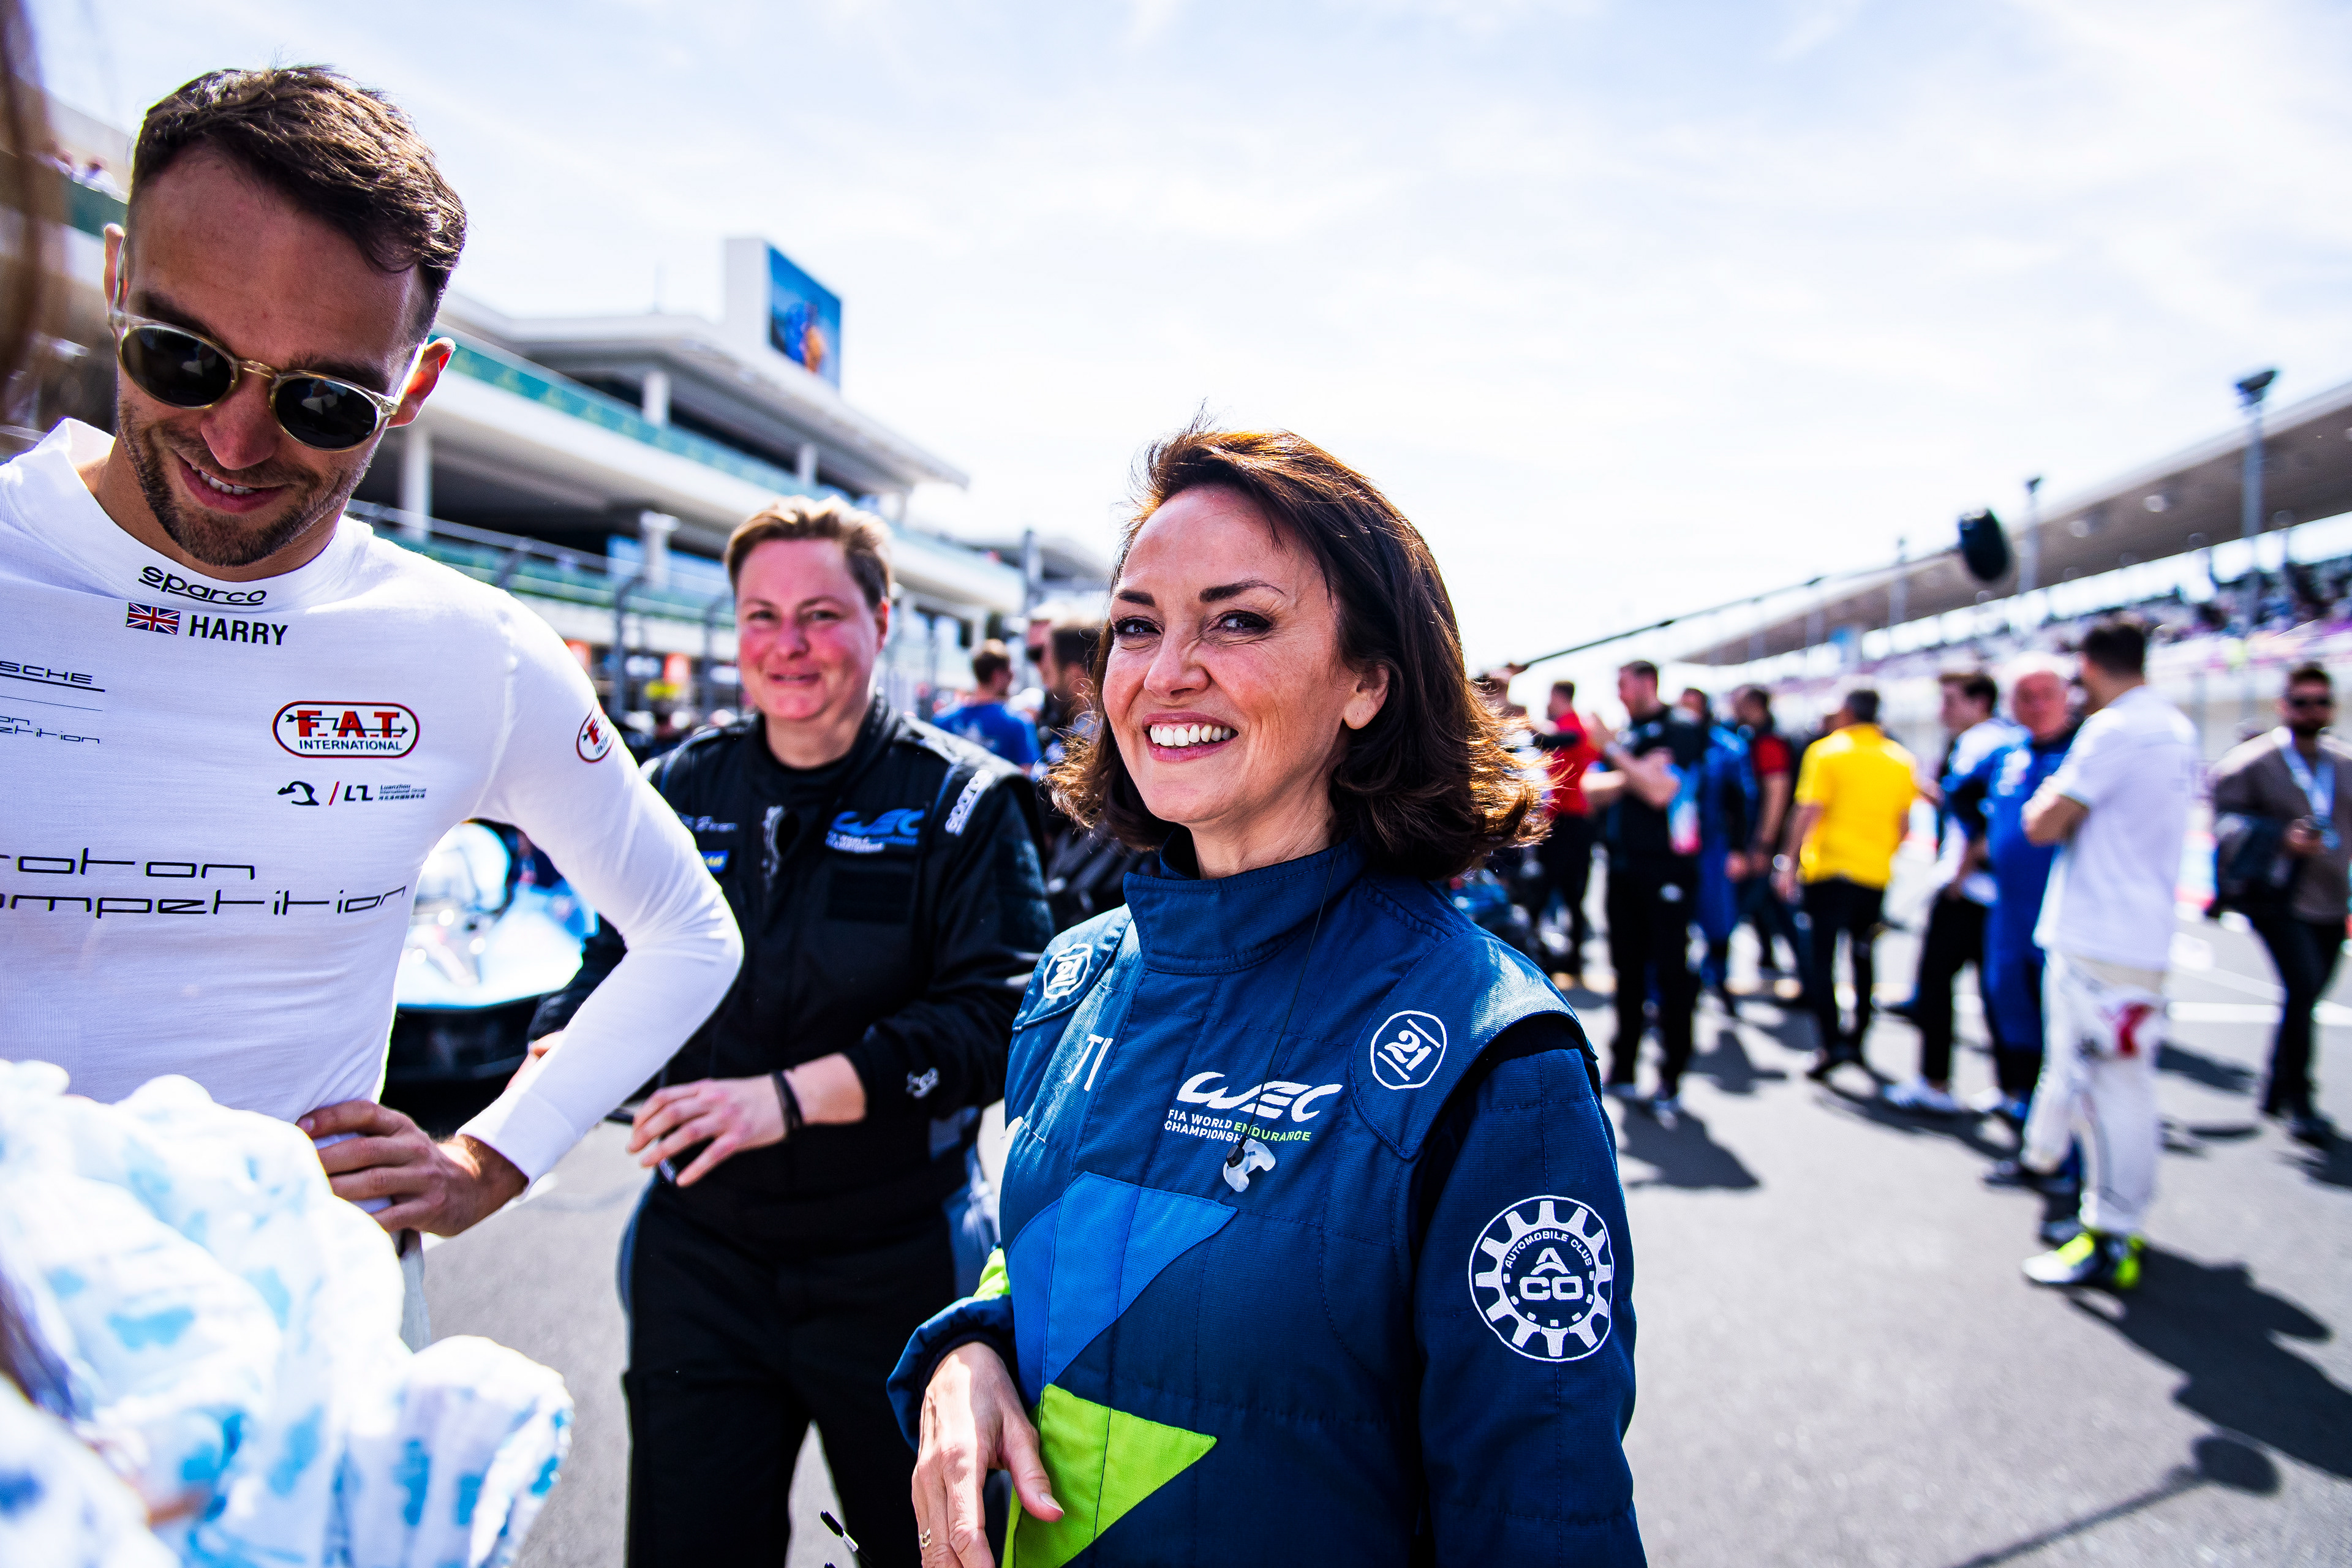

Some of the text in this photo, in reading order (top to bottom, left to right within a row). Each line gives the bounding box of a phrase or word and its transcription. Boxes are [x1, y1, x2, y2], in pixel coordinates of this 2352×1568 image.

[140, 566, 267, 604] sparco
[189, 614, 288, 646] HARRY
[299, 739, 402, 751] INTERNATIONAL
[1384, 1030, 1432, 1071] 21
[1177, 1071, 1343, 1123] WEC
[1164, 1120, 1248, 1144] CHAMPIONSH
[1168, 1109, 1312, 1142] FIA WORLD ENDURANCE
[1504, 1231, 1593, 1268] AUTOMOBILE CLUB
